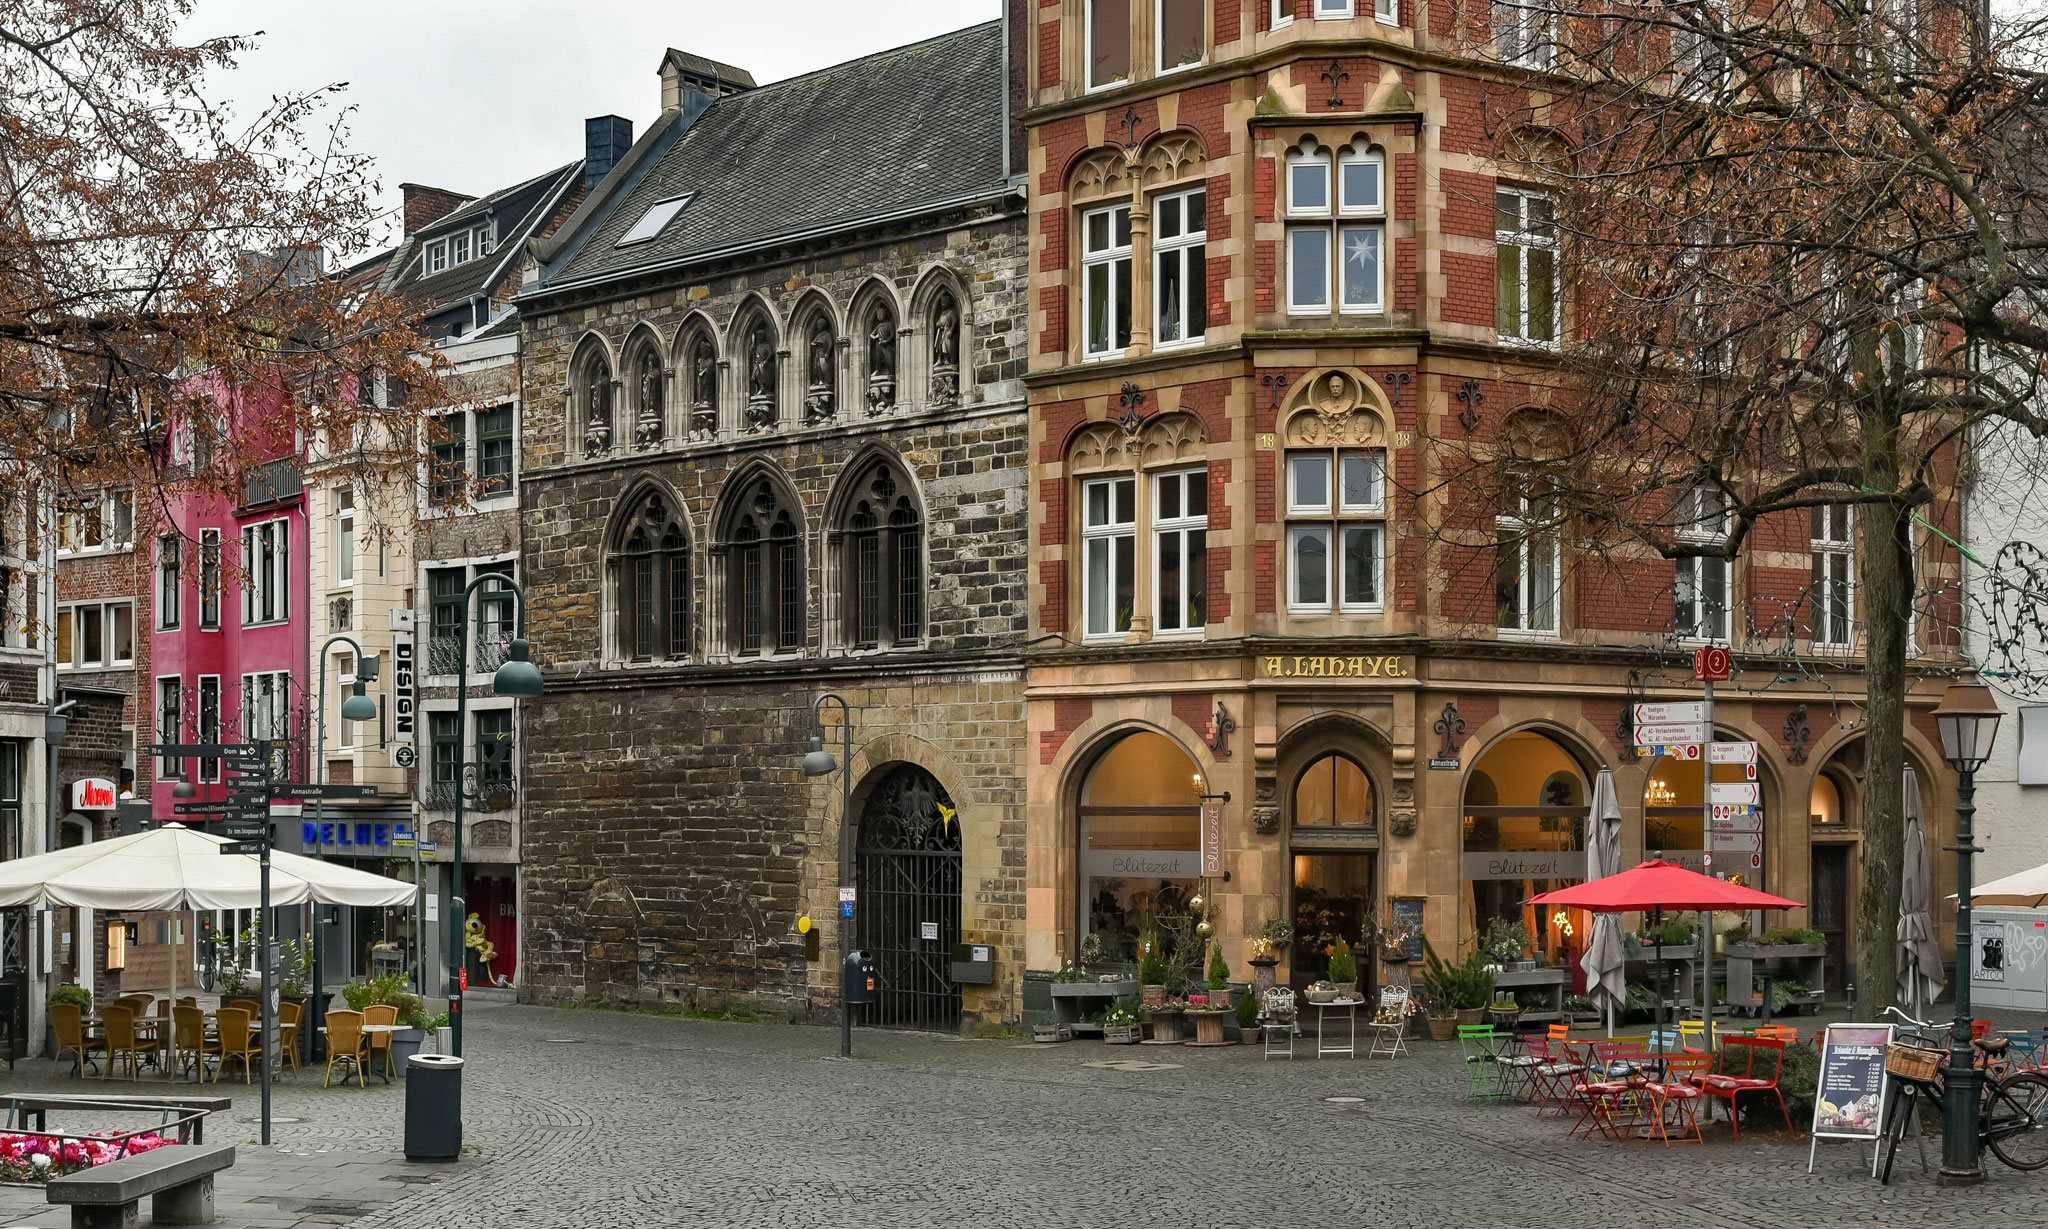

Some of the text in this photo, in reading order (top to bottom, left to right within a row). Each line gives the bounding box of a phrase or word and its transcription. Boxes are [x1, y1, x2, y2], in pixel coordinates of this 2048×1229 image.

[1260, 432, 1411, 449] 18 88
[1714, 656, 1720, 667] 2
[397, 643, 412, 733] DESIGN
[1207, 807, 1219, 873] Blütezeit
[1112, 857, 1181, 873] Blütezeit
[1488, 860, 1559, 875] Blütezeit
